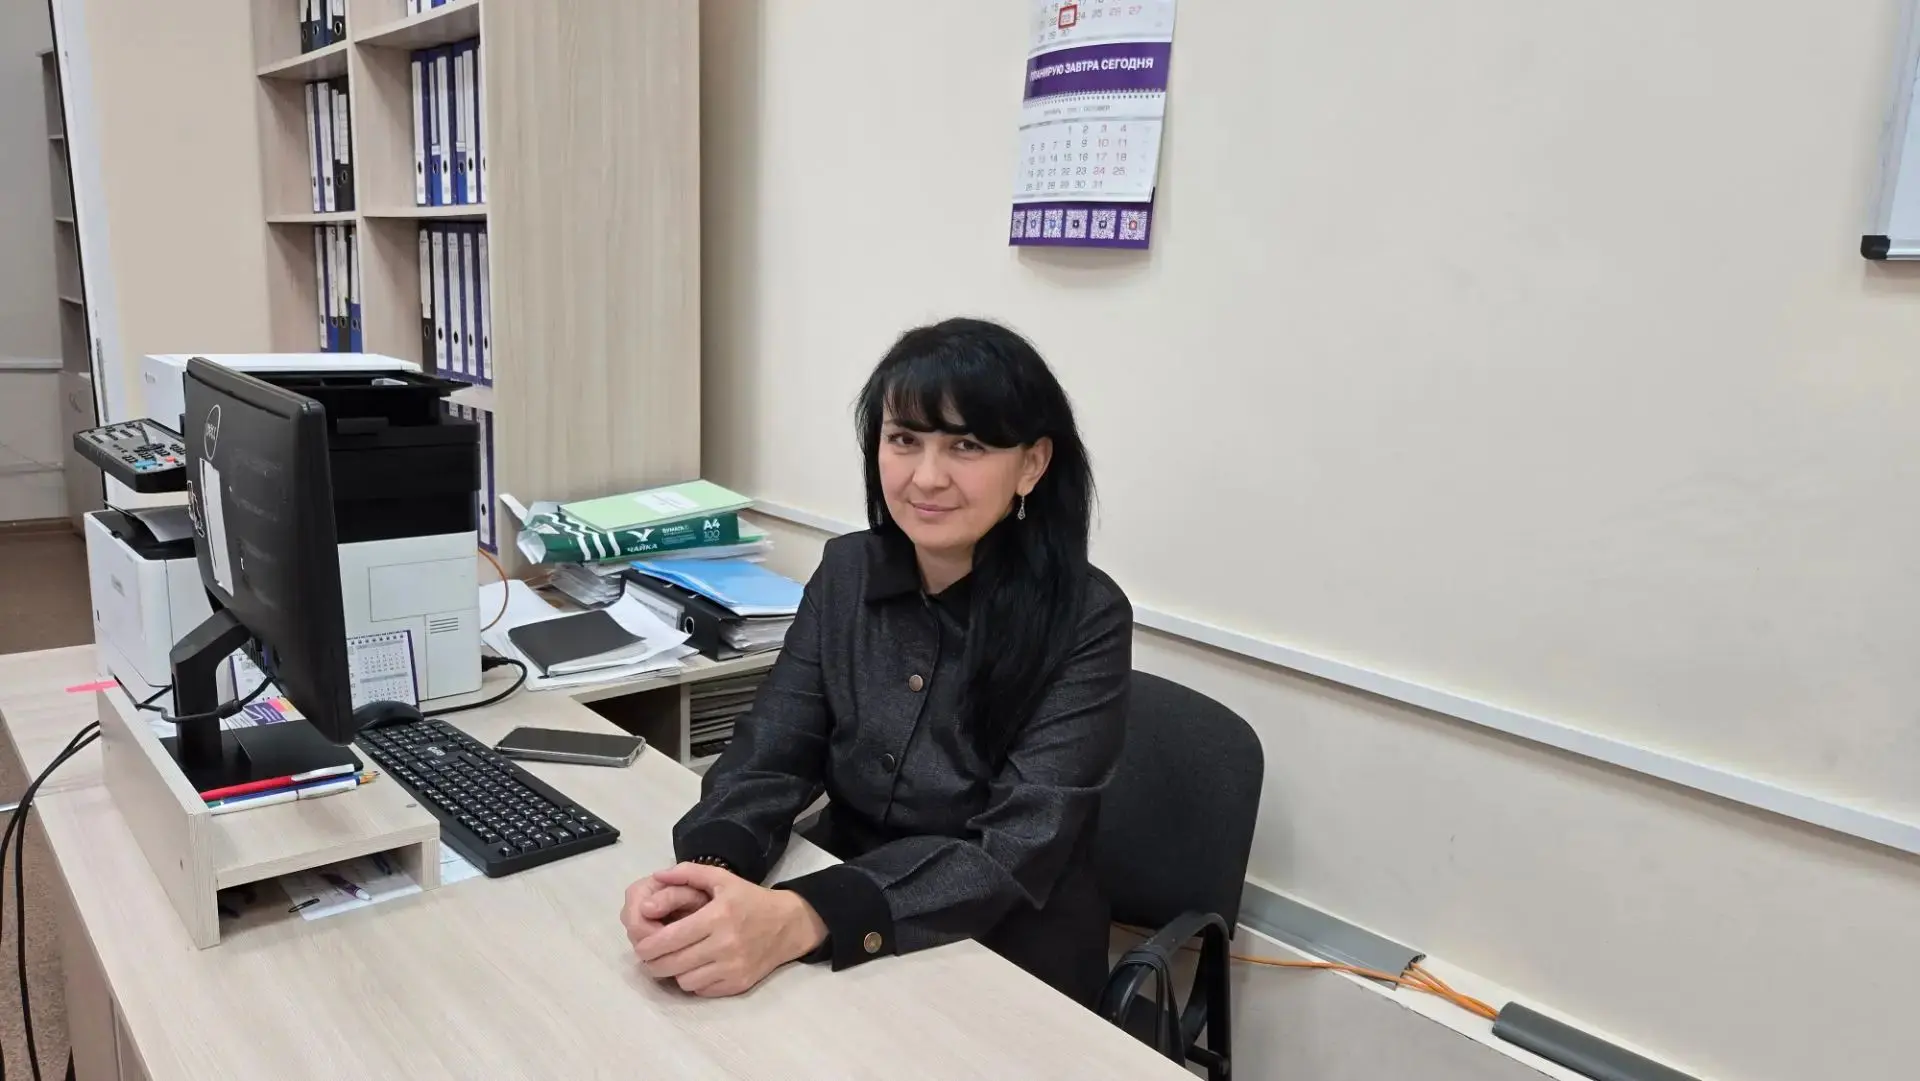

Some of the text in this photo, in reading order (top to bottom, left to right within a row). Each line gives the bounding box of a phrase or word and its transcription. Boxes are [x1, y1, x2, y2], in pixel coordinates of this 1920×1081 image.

[1065, 60, 1099, 74] ЗАВТРА
[1101, 57, 1154, 70] СЕГОДНЯ
[1082, 125, 1089, 134] 2
[1120, 123, 1127, 132] 4
[1081, 139, 1088, 148] 9
[1097, 138, 1109, 148] 10
[1079, 152, 1088, 161] 16
[1096, 152, 1107, 162] 17
[1116, 152, 1127, 161] 18
[1075, 166, 1087, 175] 23
[1112, 166, 1125, 176] 25
[627, 543, 658, 552] ЧАЙКА
